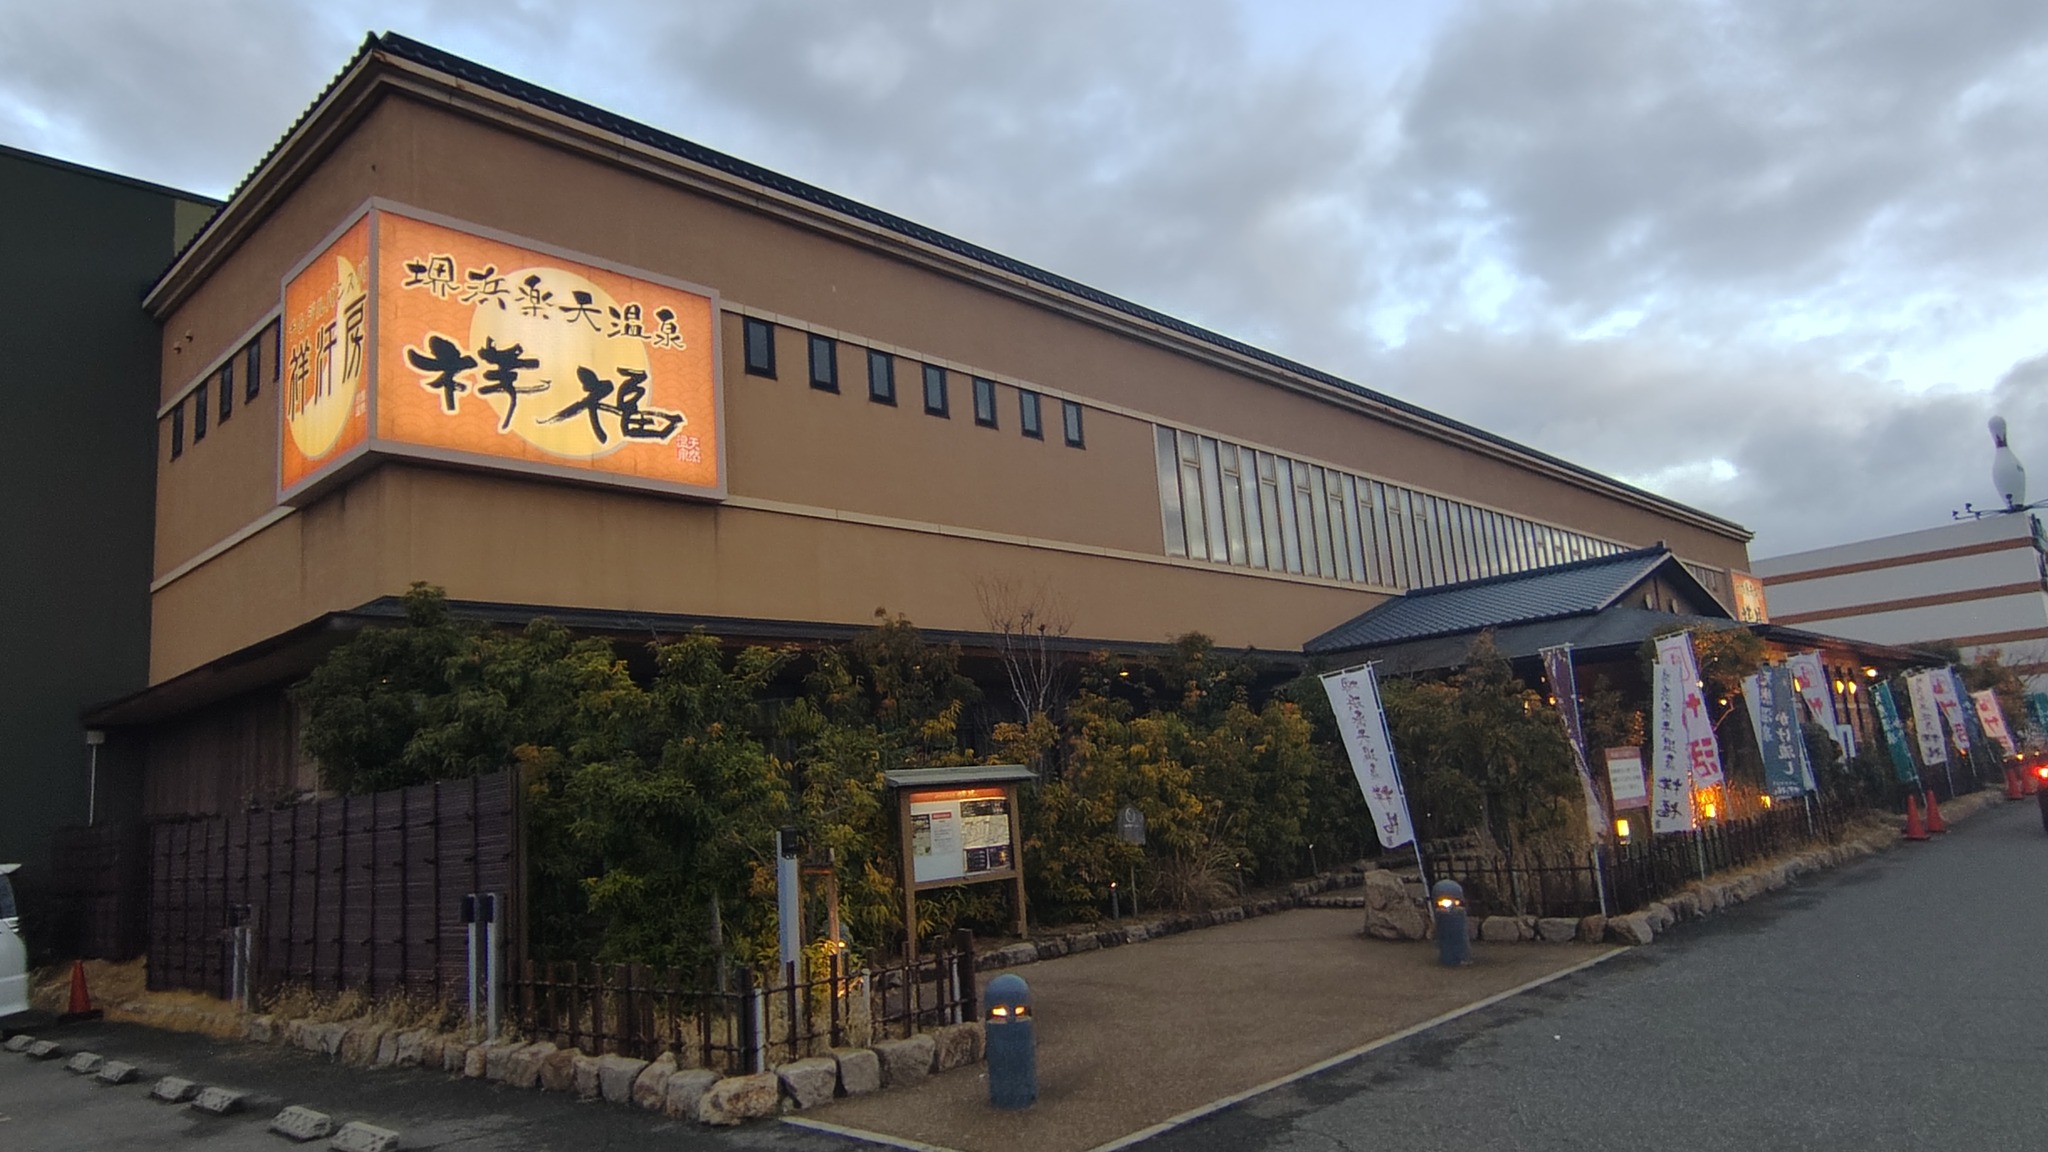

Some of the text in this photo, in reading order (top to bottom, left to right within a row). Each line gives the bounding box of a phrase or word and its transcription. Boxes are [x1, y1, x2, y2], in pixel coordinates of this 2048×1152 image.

[288, 293, 367, 421] 祥汗房
[403, 257, 686, 350] 堺浜楽天温泉
[407, 336, 686, 444] 祥福
